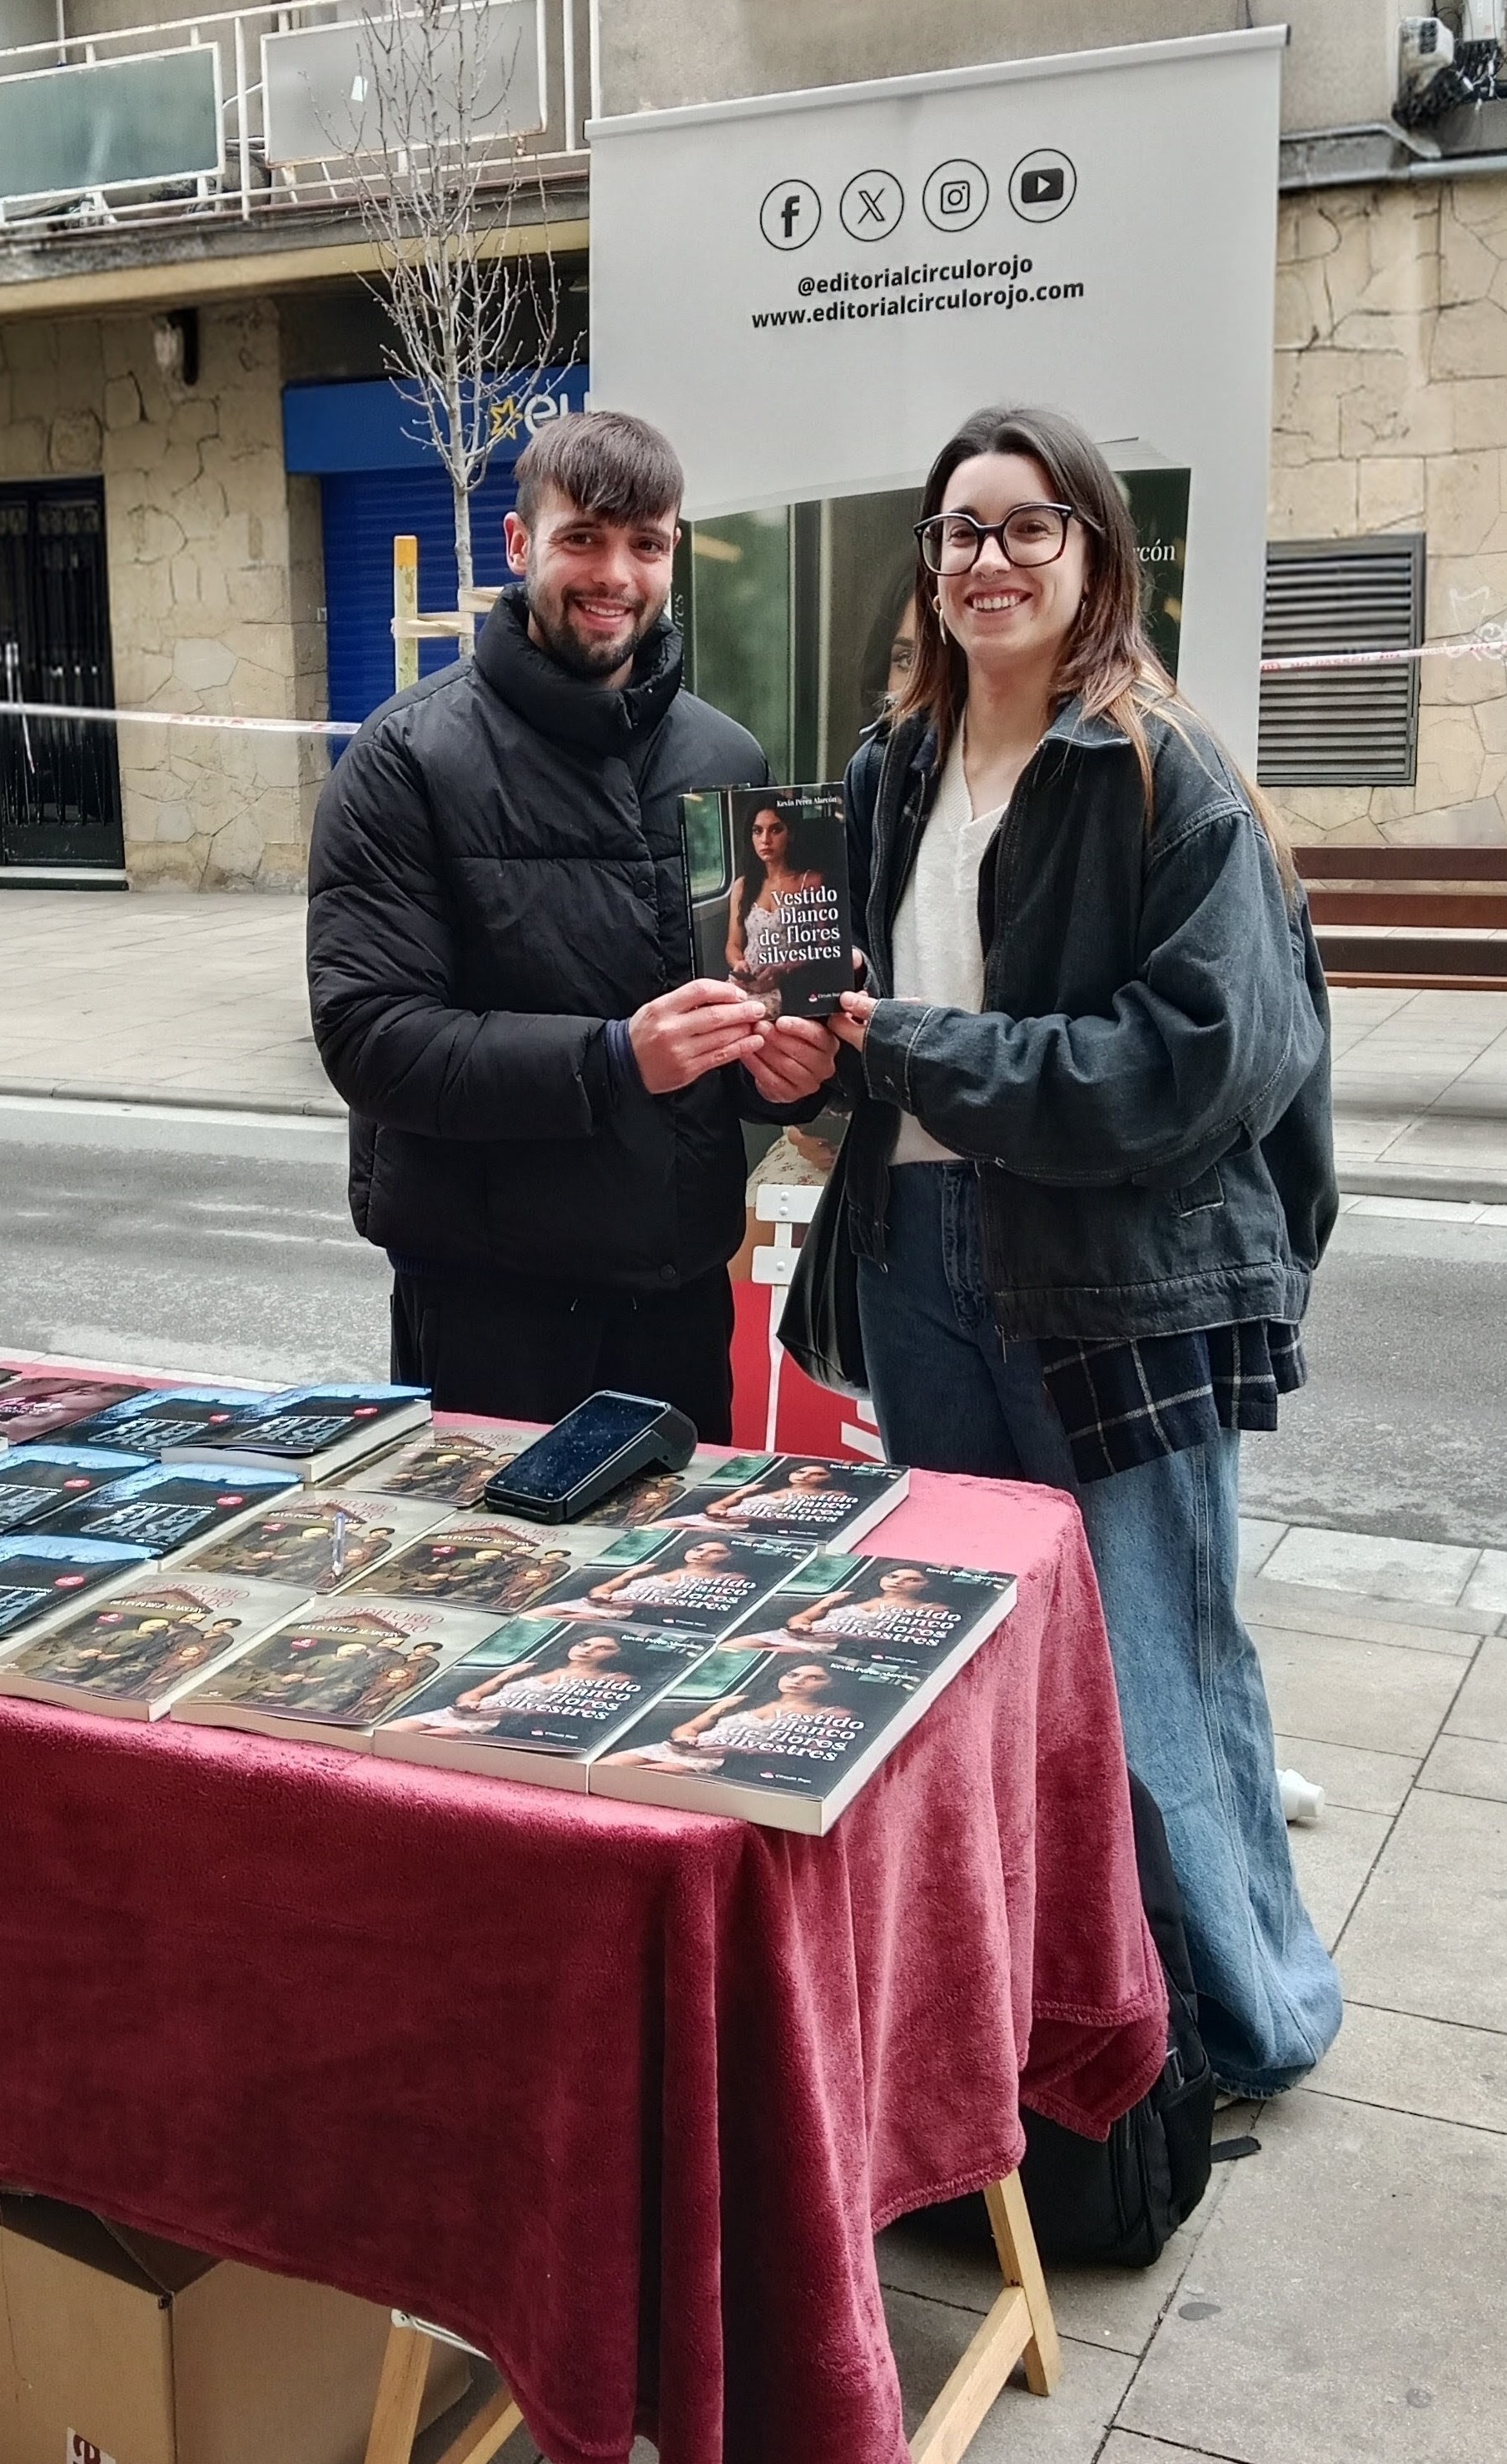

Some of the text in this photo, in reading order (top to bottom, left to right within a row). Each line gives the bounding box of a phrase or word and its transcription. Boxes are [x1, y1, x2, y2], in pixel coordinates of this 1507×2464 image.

[798, 255, 1033, 296] @editorialcirculorojo
[752, 281, 1084, 328] www.editorialcirculorojo.com
[771, 885, 838, 907] Vestido
[781, 907, 838, 925] blanco
[759, 924, 840, 946] de flores
[758, 944, 841, 964] silvestres
[877, 1612, 955, 1630] blanco
[879, 1603, 962, 1622] Vestido
[827, 1625, 940, 1646] silvestres
[873, 1621, 948, 1639] flores
[551, 1684, 631, 1701] blanco
[559, 1675, 641, 1693] Vestido
[495, 1698, 609, 1720] silvestres
[546, 1692, 622, 1712] flores
[773, 1707, 864, 1730] Vestido
[770, 1720, 856, 1740] blanco
[715, 1734, 838, 1762] silvestres
[767, 1729, 848, 1752] flores
